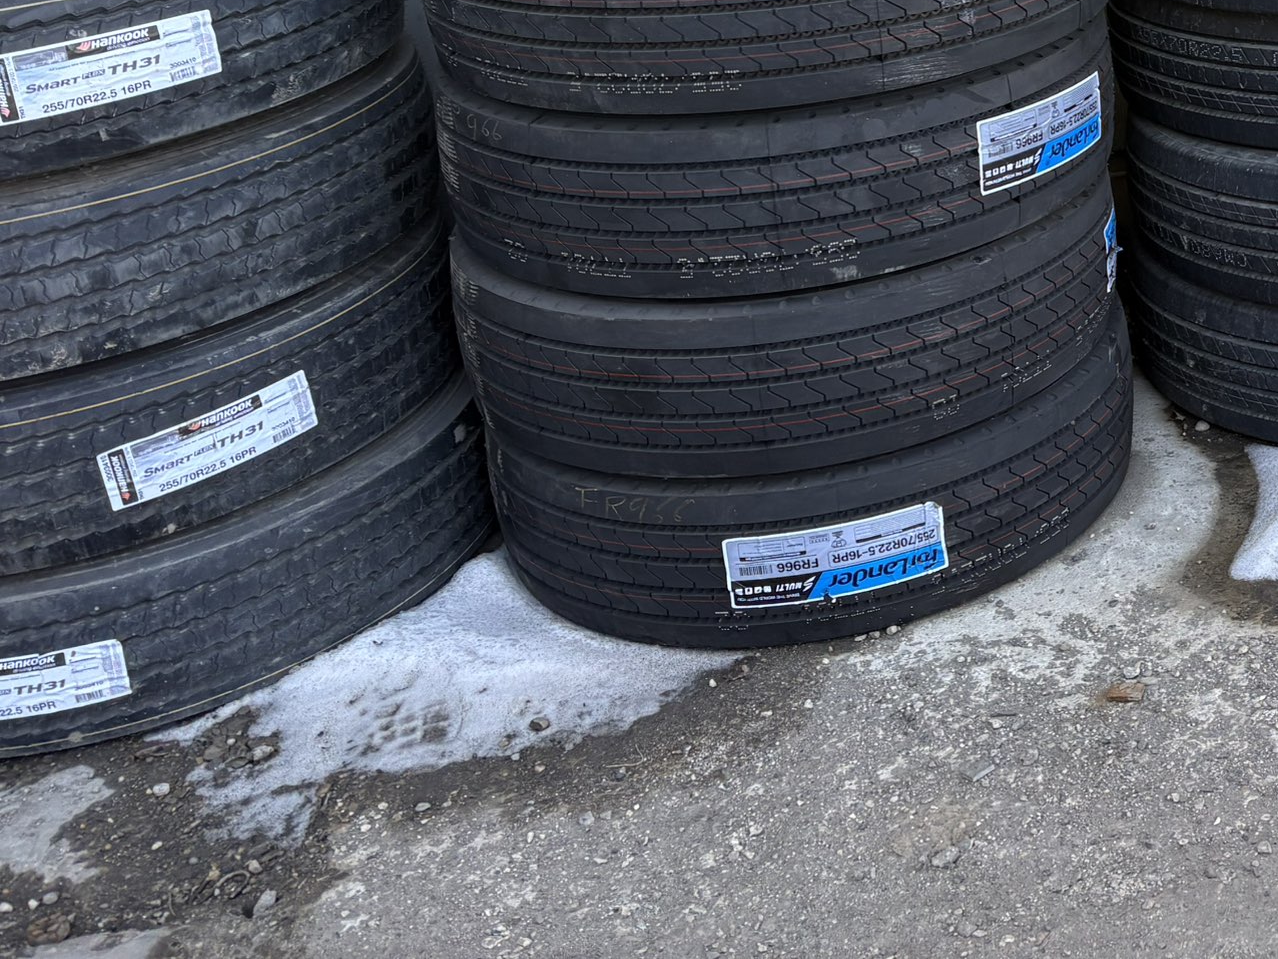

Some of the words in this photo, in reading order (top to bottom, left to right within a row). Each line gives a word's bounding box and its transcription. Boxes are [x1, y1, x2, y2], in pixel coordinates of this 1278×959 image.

[107, 54, 161, 75] TH31
[42, 88, 118, 114] 255/70R22.5
[121, 80, 152, 95] 16PR
[1016, 130, 1044, 149] FR966
[217, 421, 265, 448] TH31
[158, 460, 227, 493] 255/70R22.5
[230, 446, 257, 463] 16PR
[832, 528, 937, 564] 255/70R22.5-16PR
[776, 557, 819, 573] FR966
[775, 581, 802, 592] MULTI
[13, 679, 66, 695] TH31
[26, 701, 57, 713] 16PR
